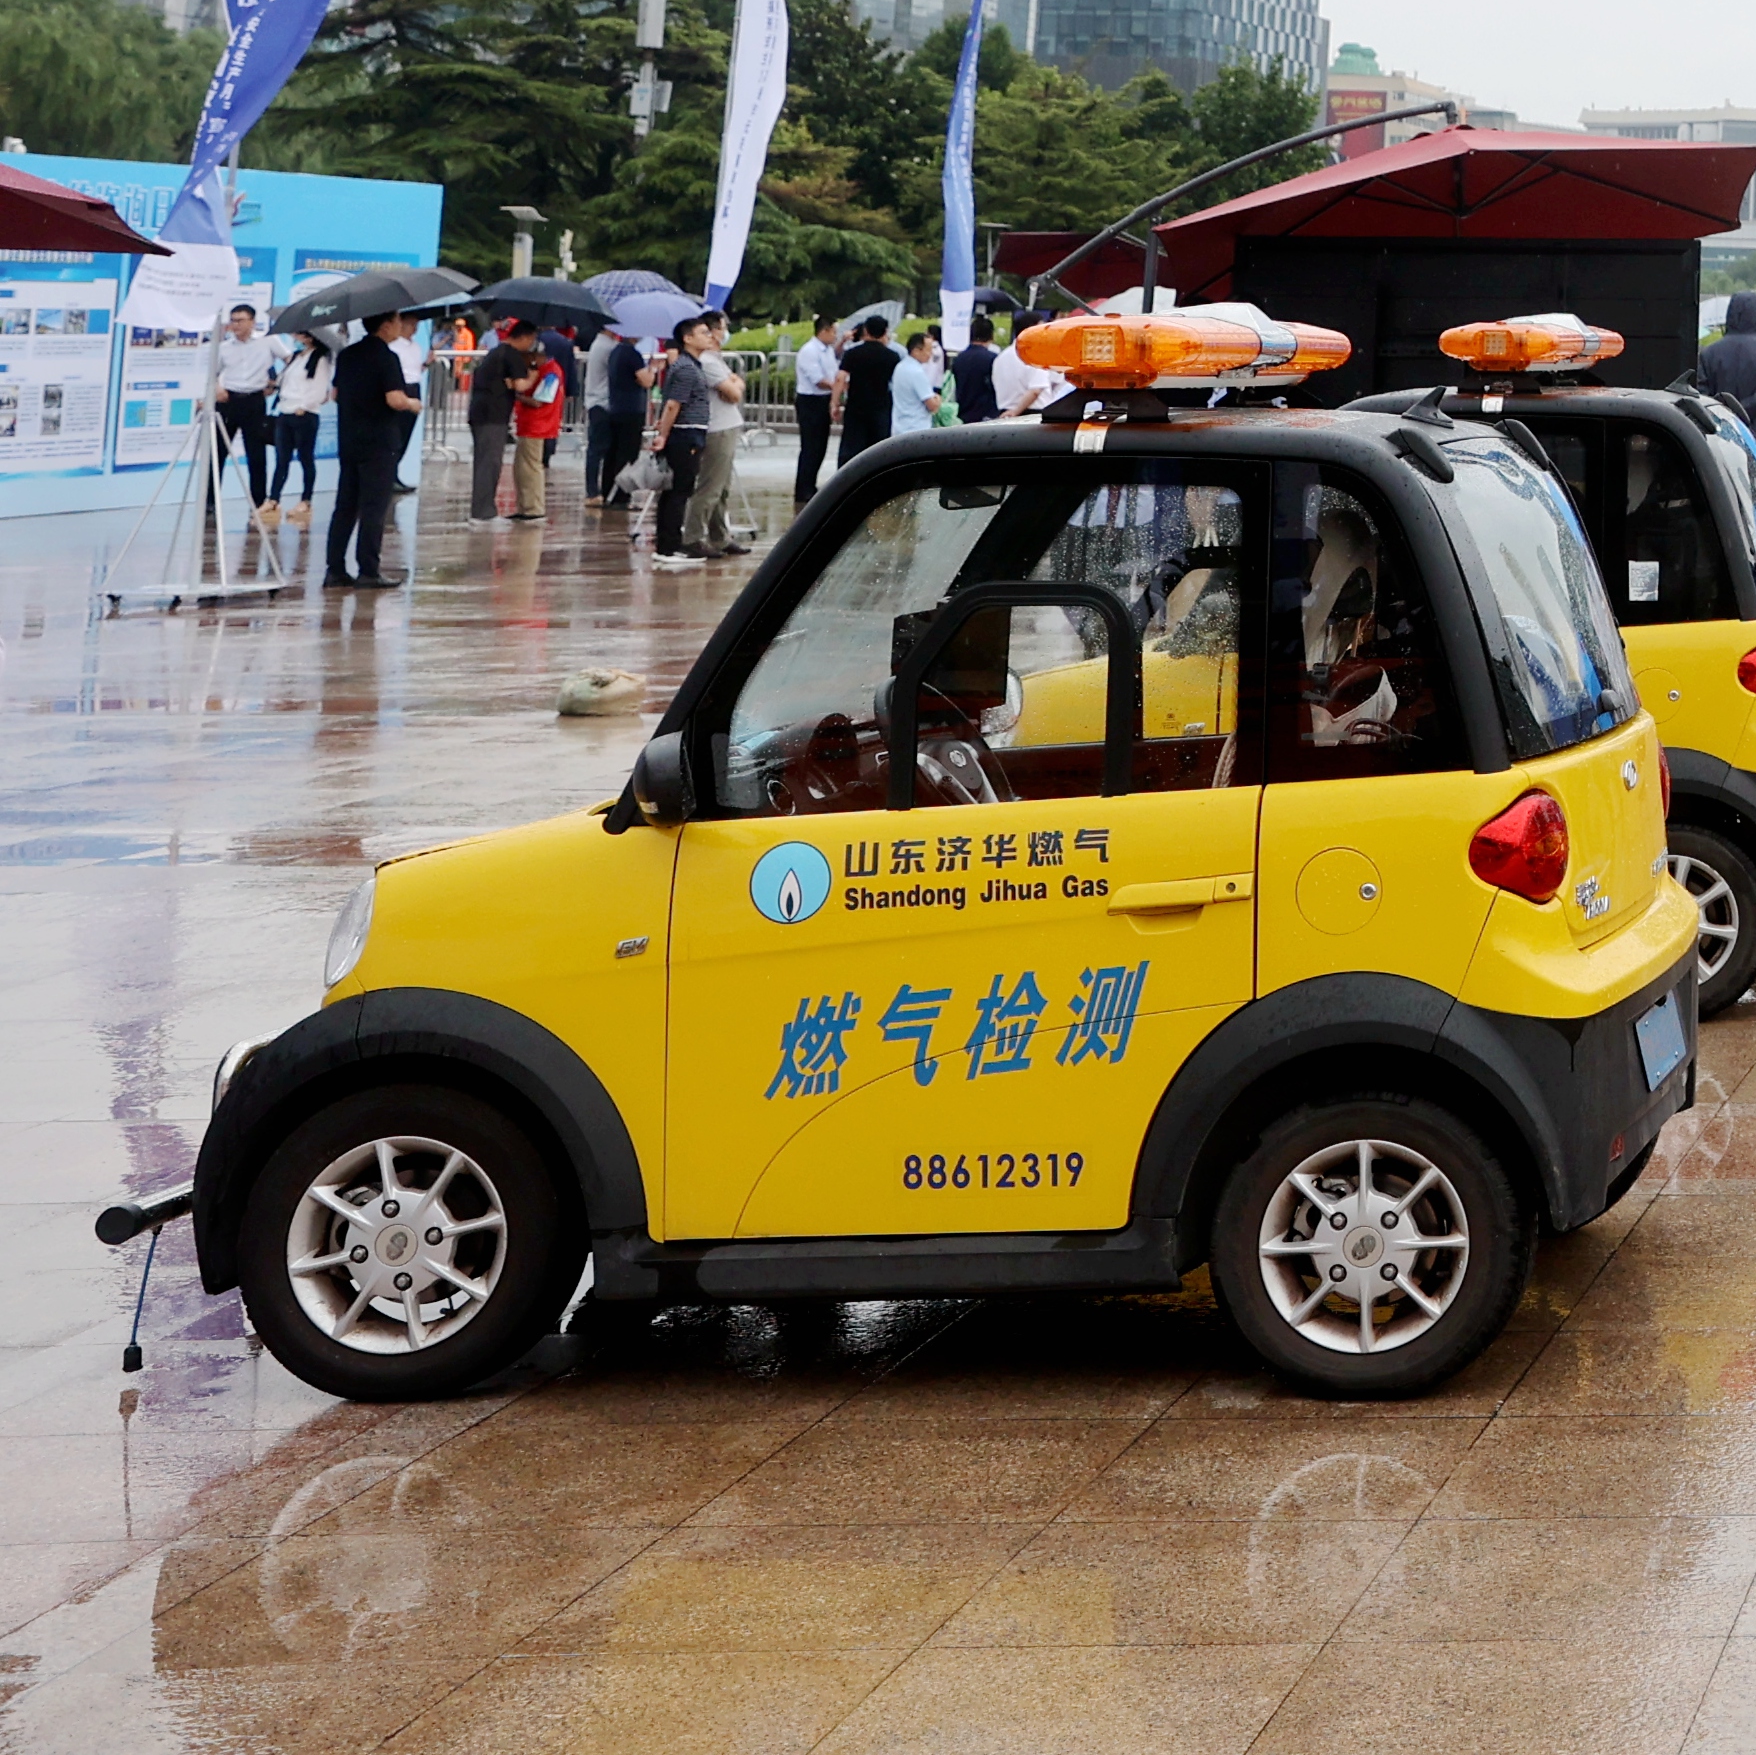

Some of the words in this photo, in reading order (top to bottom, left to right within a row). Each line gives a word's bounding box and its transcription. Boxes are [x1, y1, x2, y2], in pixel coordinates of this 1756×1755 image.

[844, 827, 1110, 878] 山东济华燃气
[844, 882, 966, 911] Shandong
[979, 878, 1048, 904] Jihua
[1061, 874, 1109, 898] Gas
[762, 959, 1151, 1101] 燃气检测
[902, 1151, 1085, 1191] 88612319
